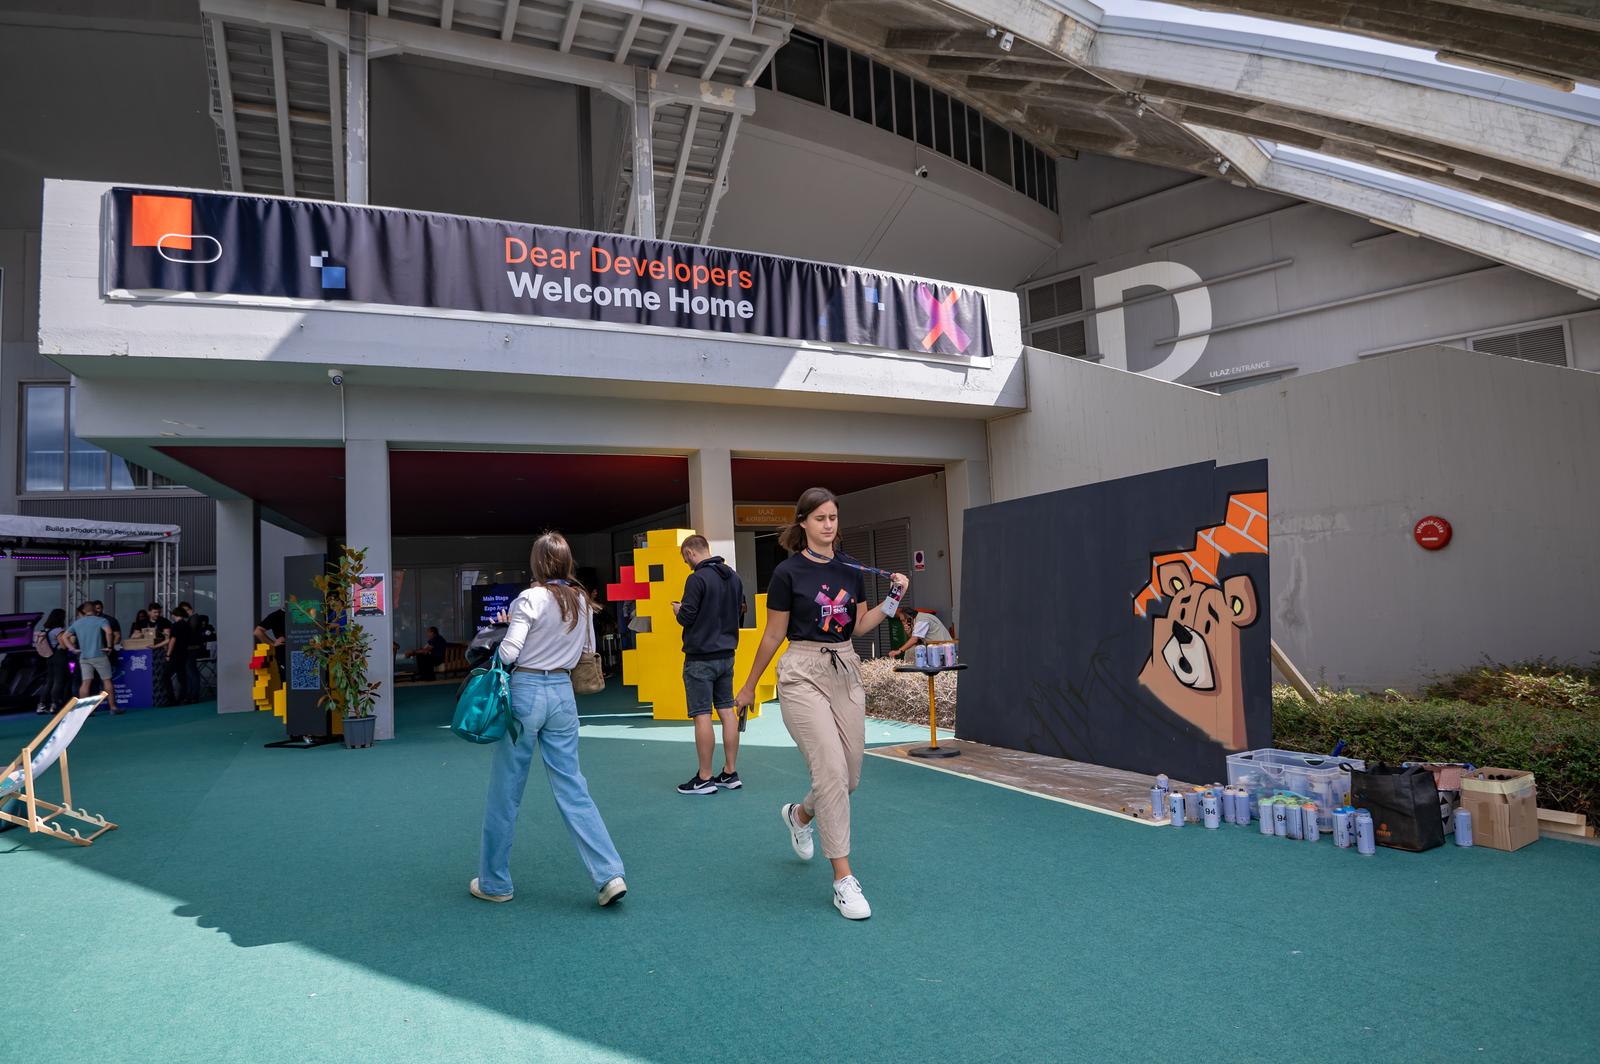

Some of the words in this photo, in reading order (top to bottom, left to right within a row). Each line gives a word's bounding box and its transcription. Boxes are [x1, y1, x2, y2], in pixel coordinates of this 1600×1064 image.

[504, 236, 581, 271] Dear
[590, 246, 753, 290] Developers
[506, 270, 661, 312] Welcome
[668, 286, 754, 320] Home
[1093, 261, 1213, 382] D
[45, 525, 65, 533] Build
[70, 526, 98, 535] Product
[1204, 807, 1217, 815] 94
